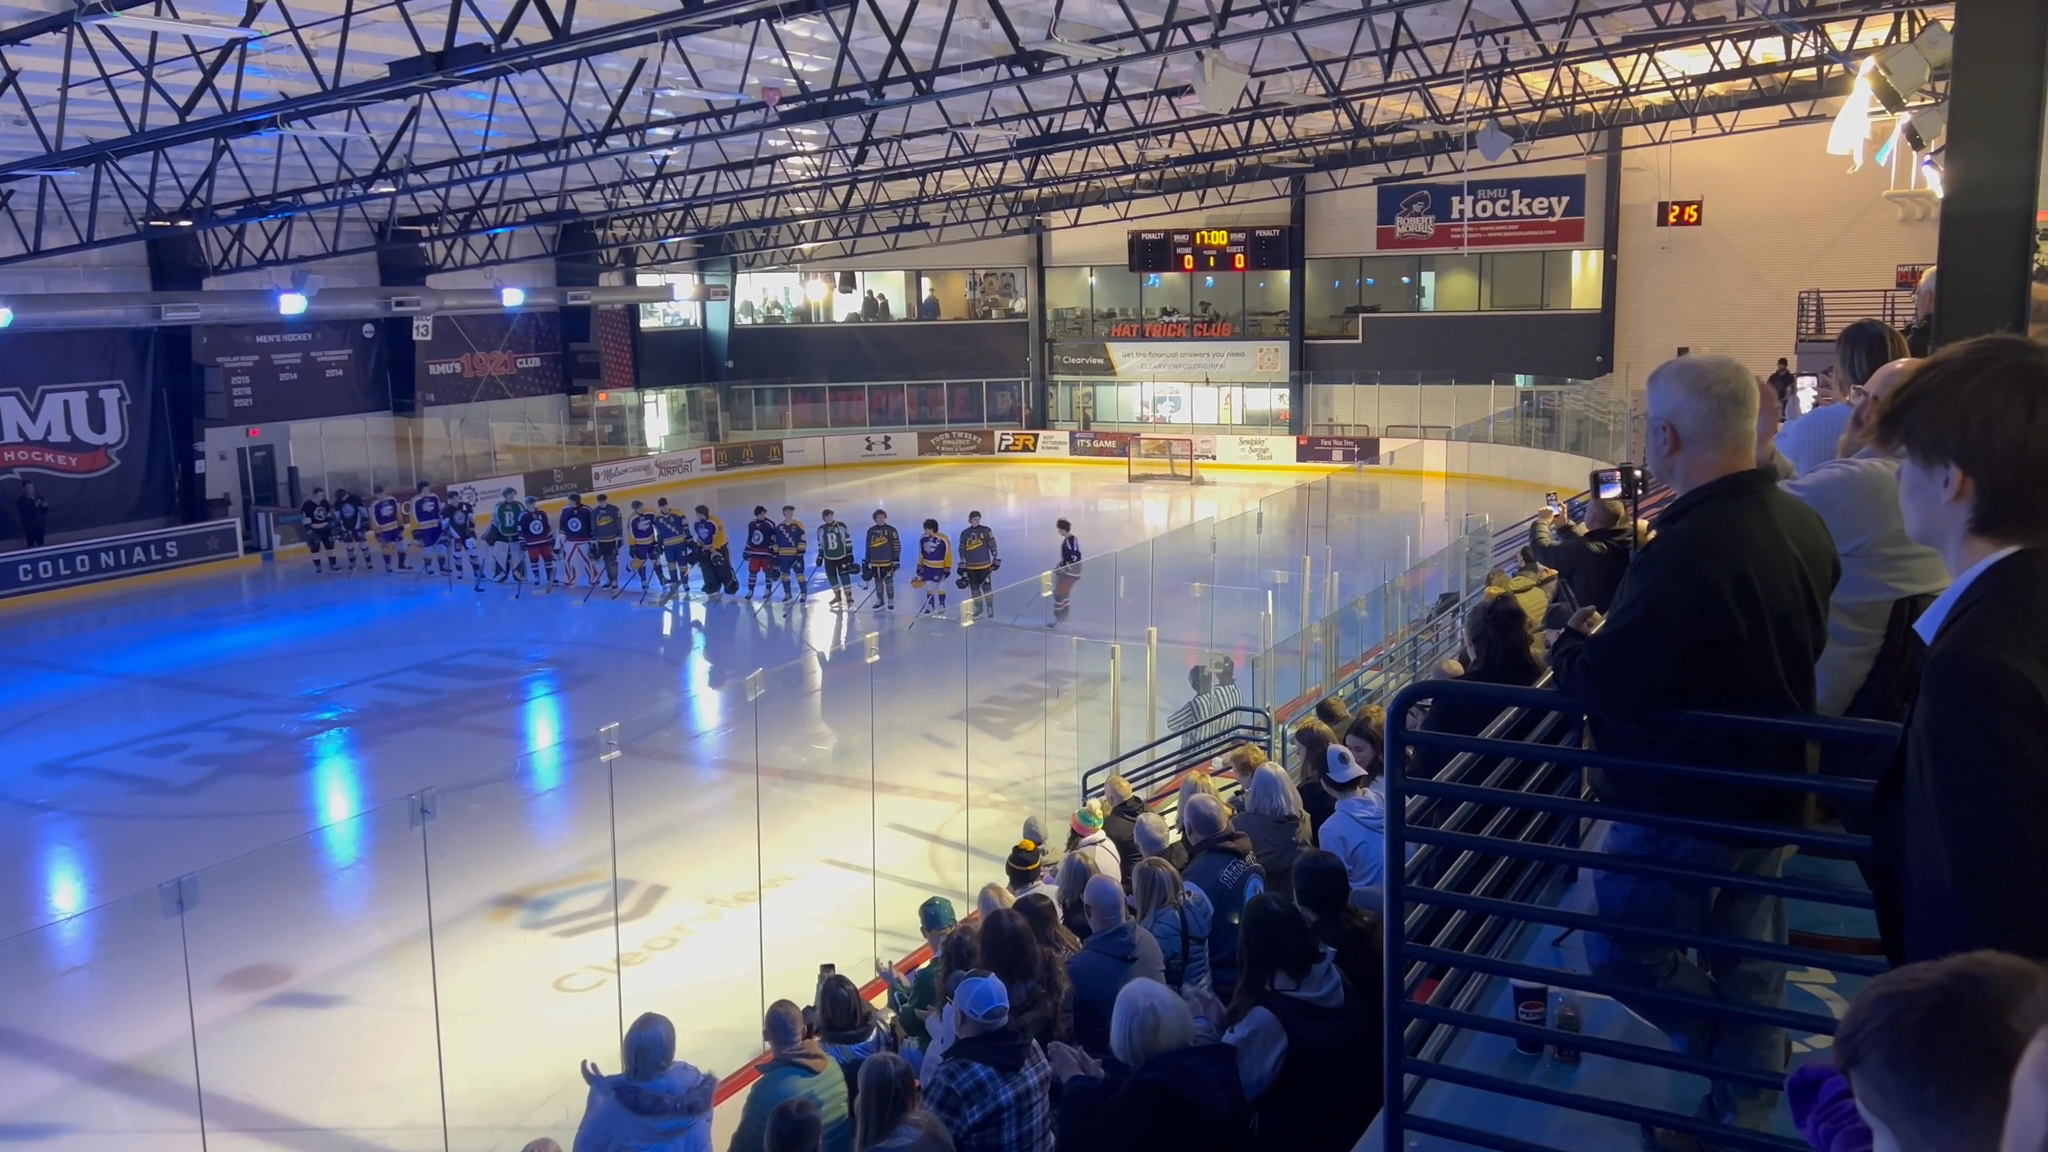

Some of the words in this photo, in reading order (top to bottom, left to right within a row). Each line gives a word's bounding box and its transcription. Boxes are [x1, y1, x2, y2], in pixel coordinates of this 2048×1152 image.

[1477, 188, 1508, 200] RMU
[1451, 189, 1570, 222] Hockey
[1396, 216, 1437, 227] ROBERT
[1196, 230, 1228, 244] 17:00
[1396, 224, 1434, 238] MORRIS
[1174, 234, 1190, 242] RMU
[1184, 254, 1194, 269] 0
[1209, 256, 1214, 267] 1
[1234, 253, 1245, 268] 0
[414, 324, 430, 337] 13
[1111, 324, 1140, 337] HAT
[1144, 323, 1187, 337] TRICK
[1193, 322, 1232, 337] CLUB
[256, 333, 281, 343] MEN'S
[282, 333, 312, 342] HOCKEY
[1121, 351, 1135, 359] Get
[429, 362, 462, 375] RMU'S
[460, 350, 518, 378] 1921
[516, 357, 541, 368] CLUB
[279, 373, 298, 381] 2014
[325, 369, 343, 377] 2014
[231, 376, 250, 384] 2015
[234, 399, 253, 407] 2021
[930, 432, 951, 445] FOUR
[951, 431, 983, 444] TWELVE
[1077, 440, 1091, 448] IT'S
[1092, 440, 1117, 448] GAME
[4, 450, 78, 466] HOCKEY
[658, 458, 697, 478] AIRPORT
[542, 483, 578, 494] SHERATON
[503, 511, 514, 527] B
[827, 532, 838, 550] B
[18, 541, 179, 582] COLONIALS
